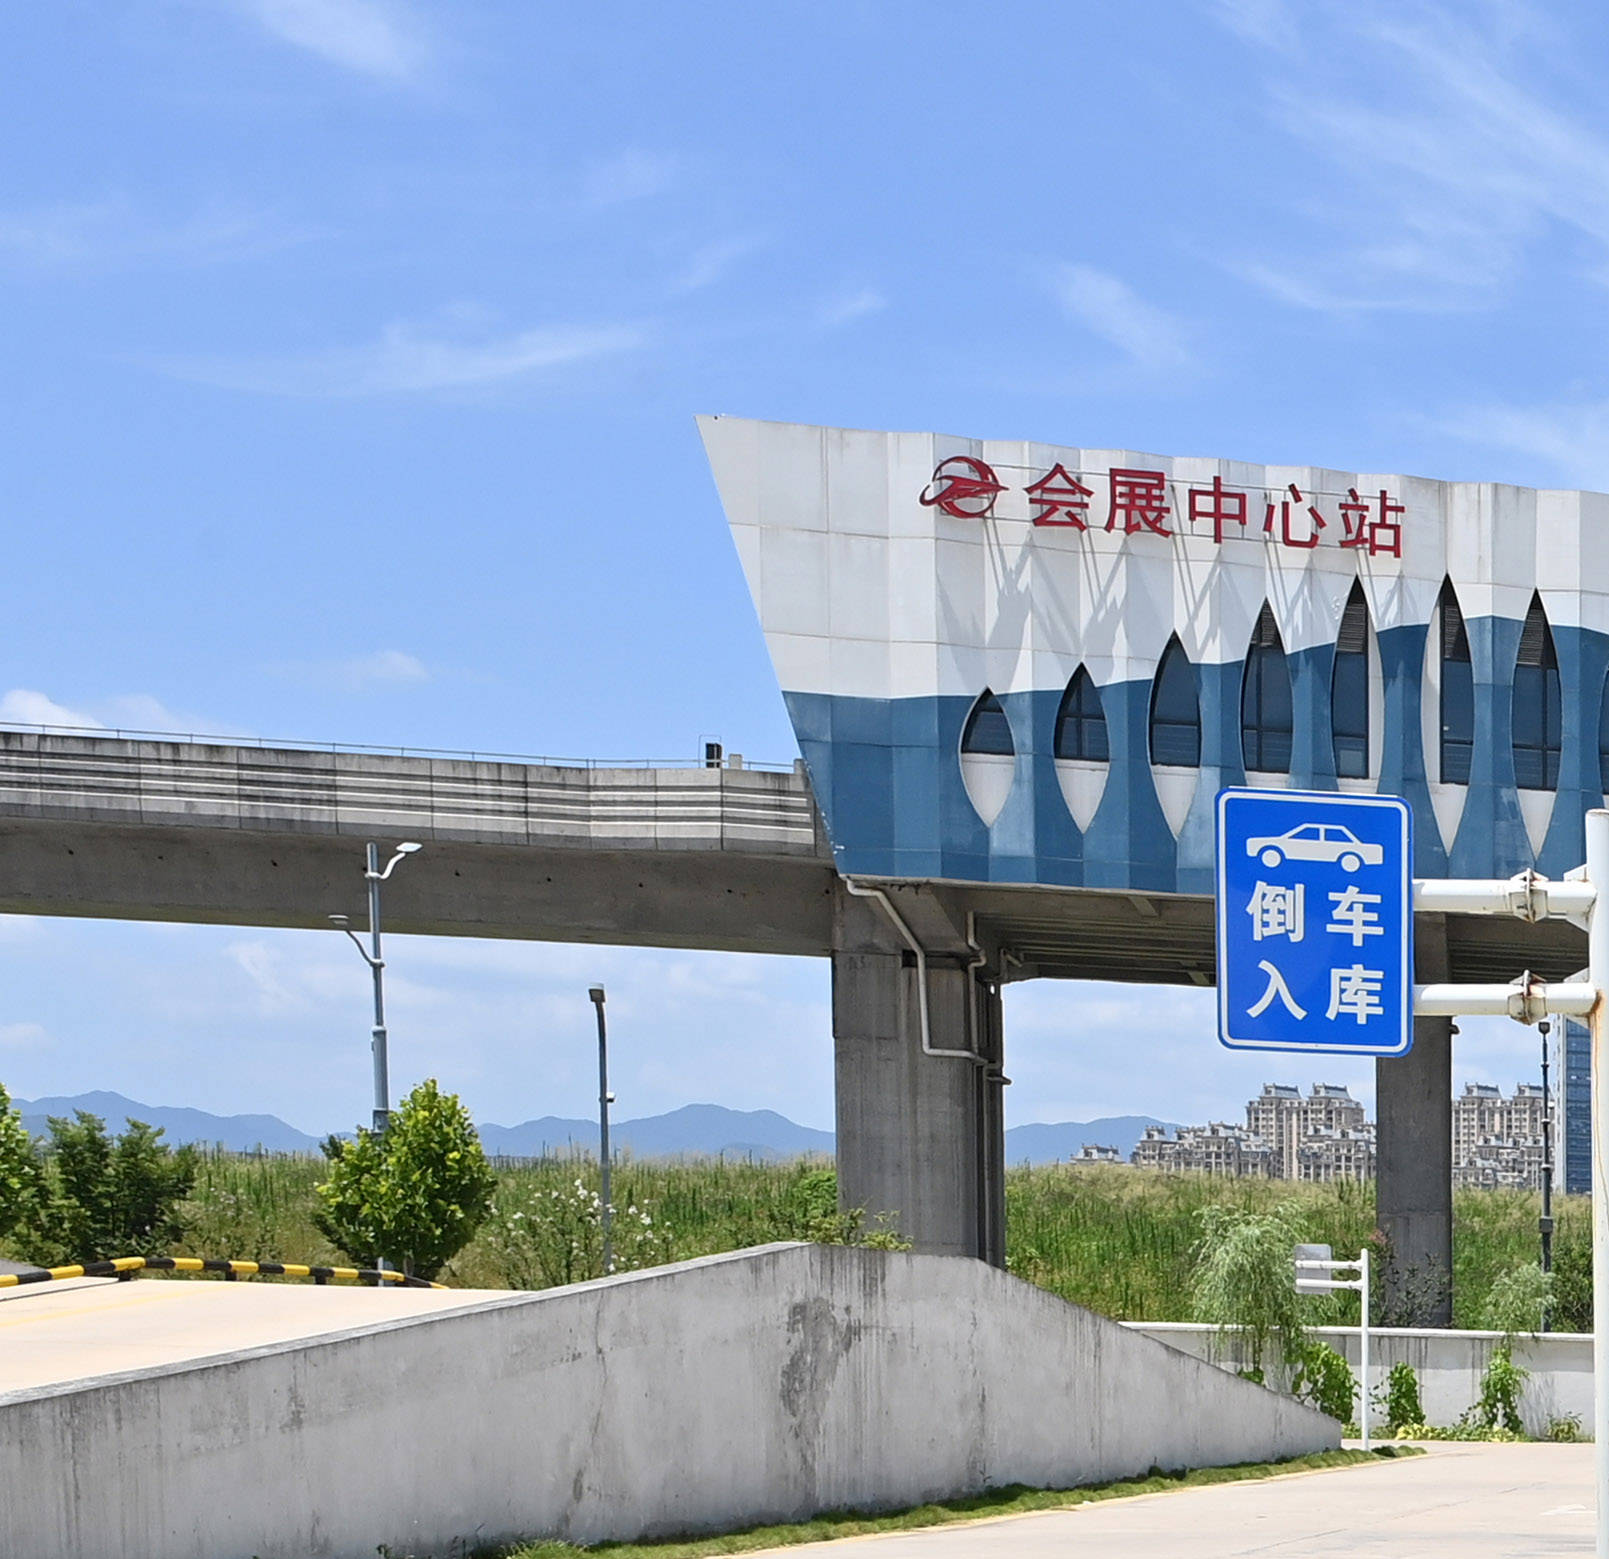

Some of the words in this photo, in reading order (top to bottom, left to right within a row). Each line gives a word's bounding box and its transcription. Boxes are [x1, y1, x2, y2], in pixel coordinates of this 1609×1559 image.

[1024, 463, 1405, 558] 会展中心站
[1246, 881, 1384, 947] 倒车
[1246, 960, 1384, 1026] 入库
